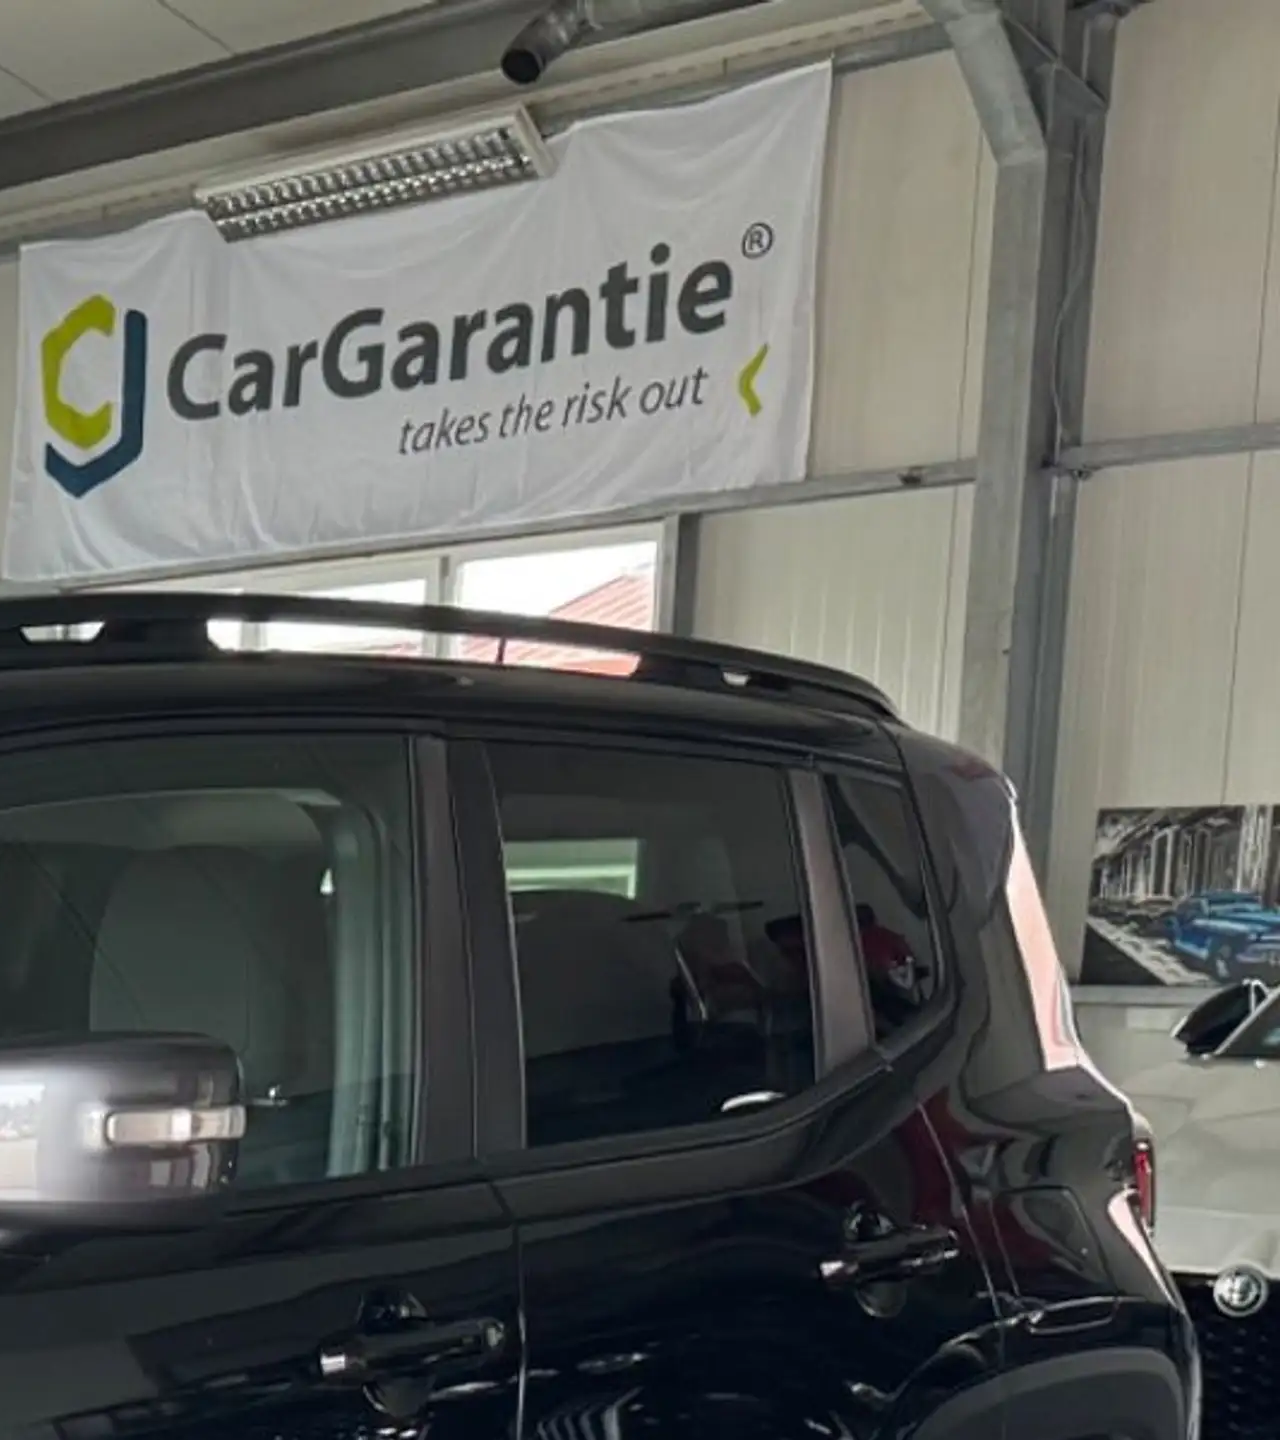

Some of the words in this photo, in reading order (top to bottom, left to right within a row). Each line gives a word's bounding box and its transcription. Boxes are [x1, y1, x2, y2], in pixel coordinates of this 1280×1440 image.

[398, 407, 492, 455] takes
[498, 393, 555, 438] the
[561, 374, 632, 428] risk
[639, 366, 709, 415] out
